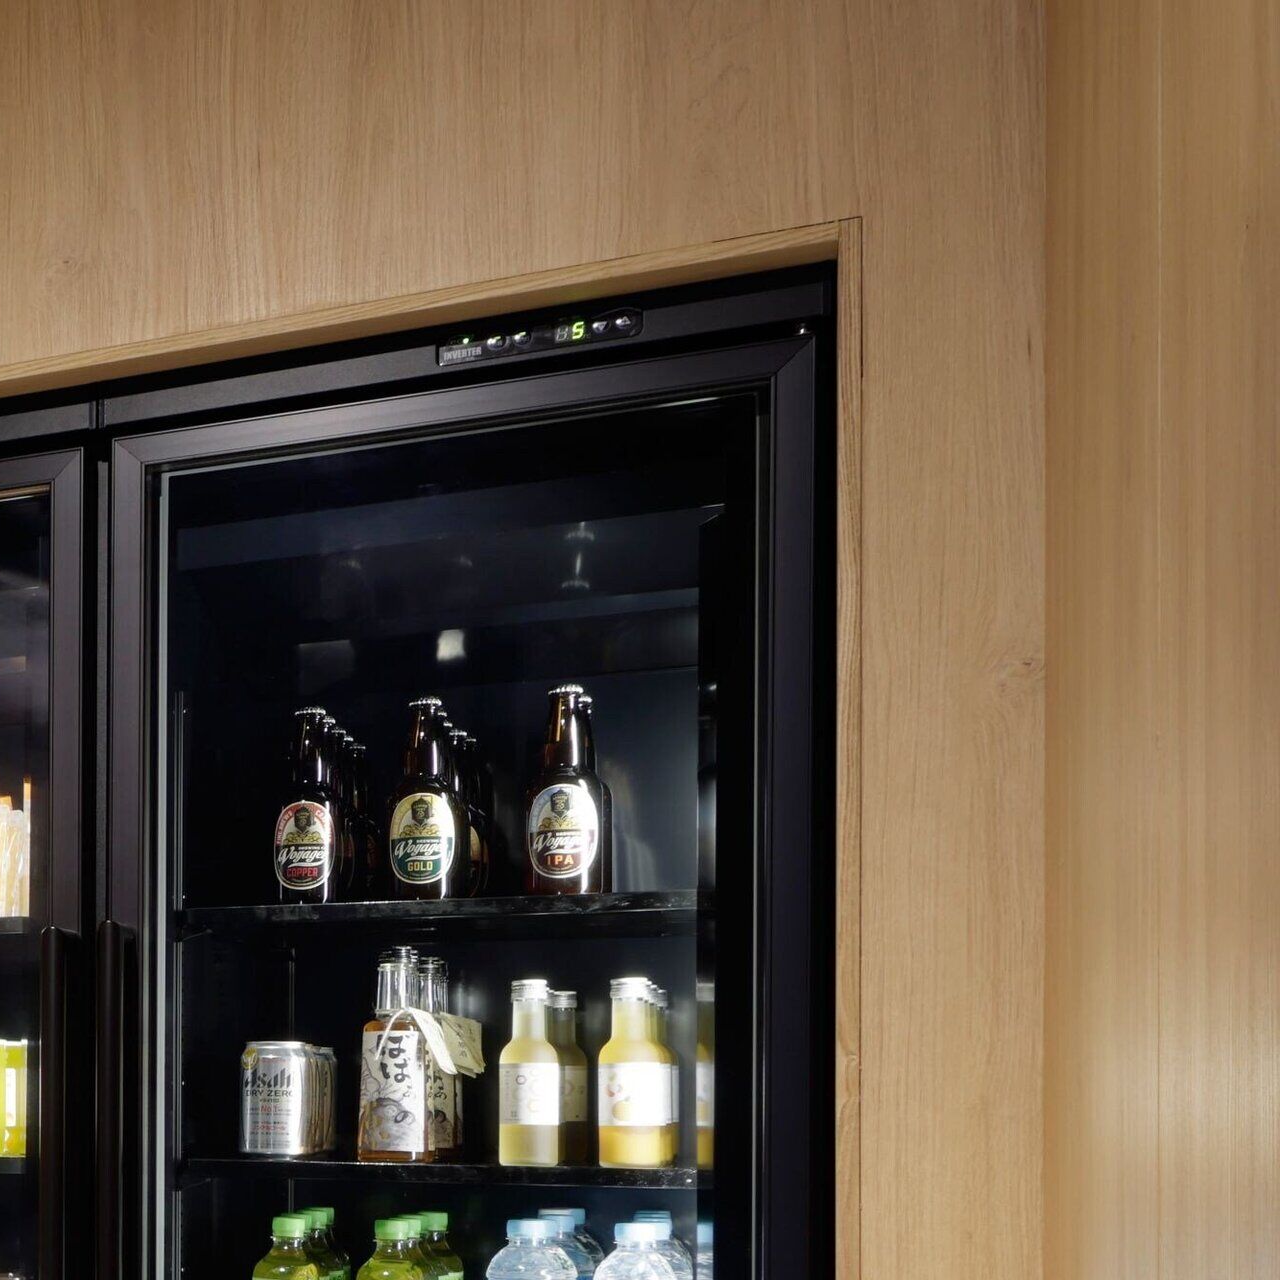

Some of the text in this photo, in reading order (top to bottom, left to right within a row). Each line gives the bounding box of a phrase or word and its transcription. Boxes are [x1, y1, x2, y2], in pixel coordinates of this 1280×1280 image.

[443, 346, 482, 361] INVERTER
[406, 861, 434, 873] GOLD
[546, 854, 575, 868] IPA
[286, 866, 319, 879] COPPER
[244, 1067, 294, 1089] Asahi
[244, 1090, 263, 1098] DRY
